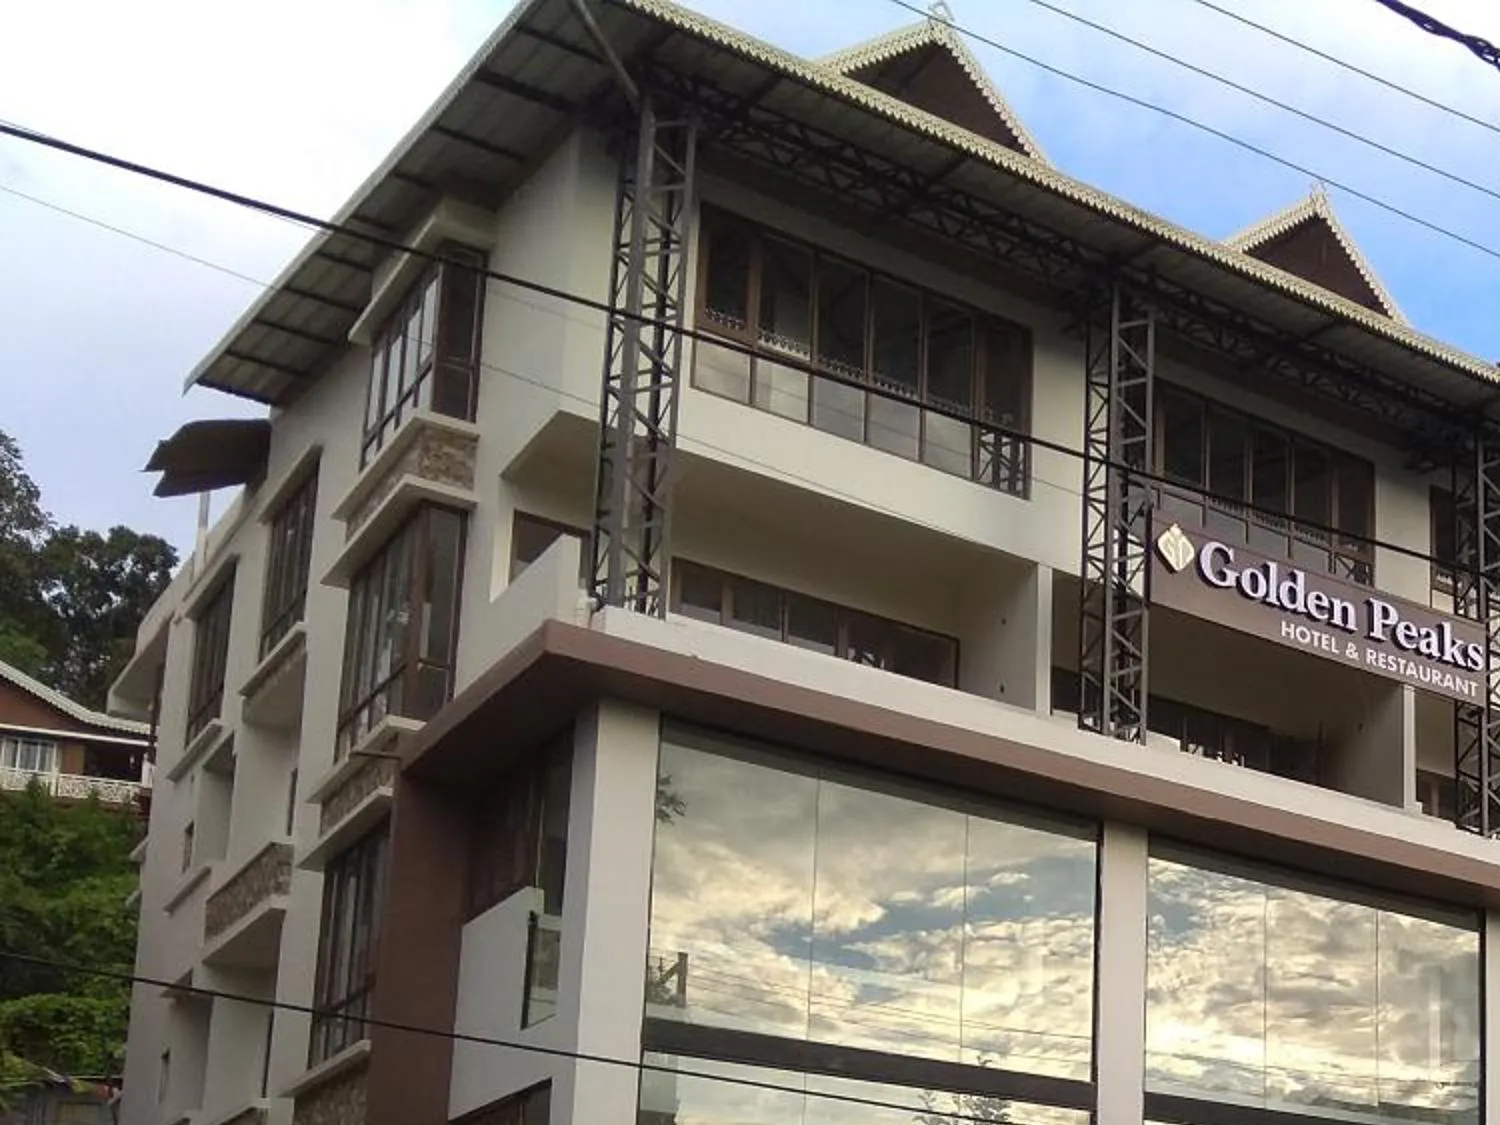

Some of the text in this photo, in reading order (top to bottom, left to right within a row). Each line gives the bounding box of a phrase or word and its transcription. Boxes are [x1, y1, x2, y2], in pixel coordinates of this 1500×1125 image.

[1200, 541, 1485, 672] Golden Peaks
[1281, 620, 1479, 697] HOTEL & RESTAURANT
